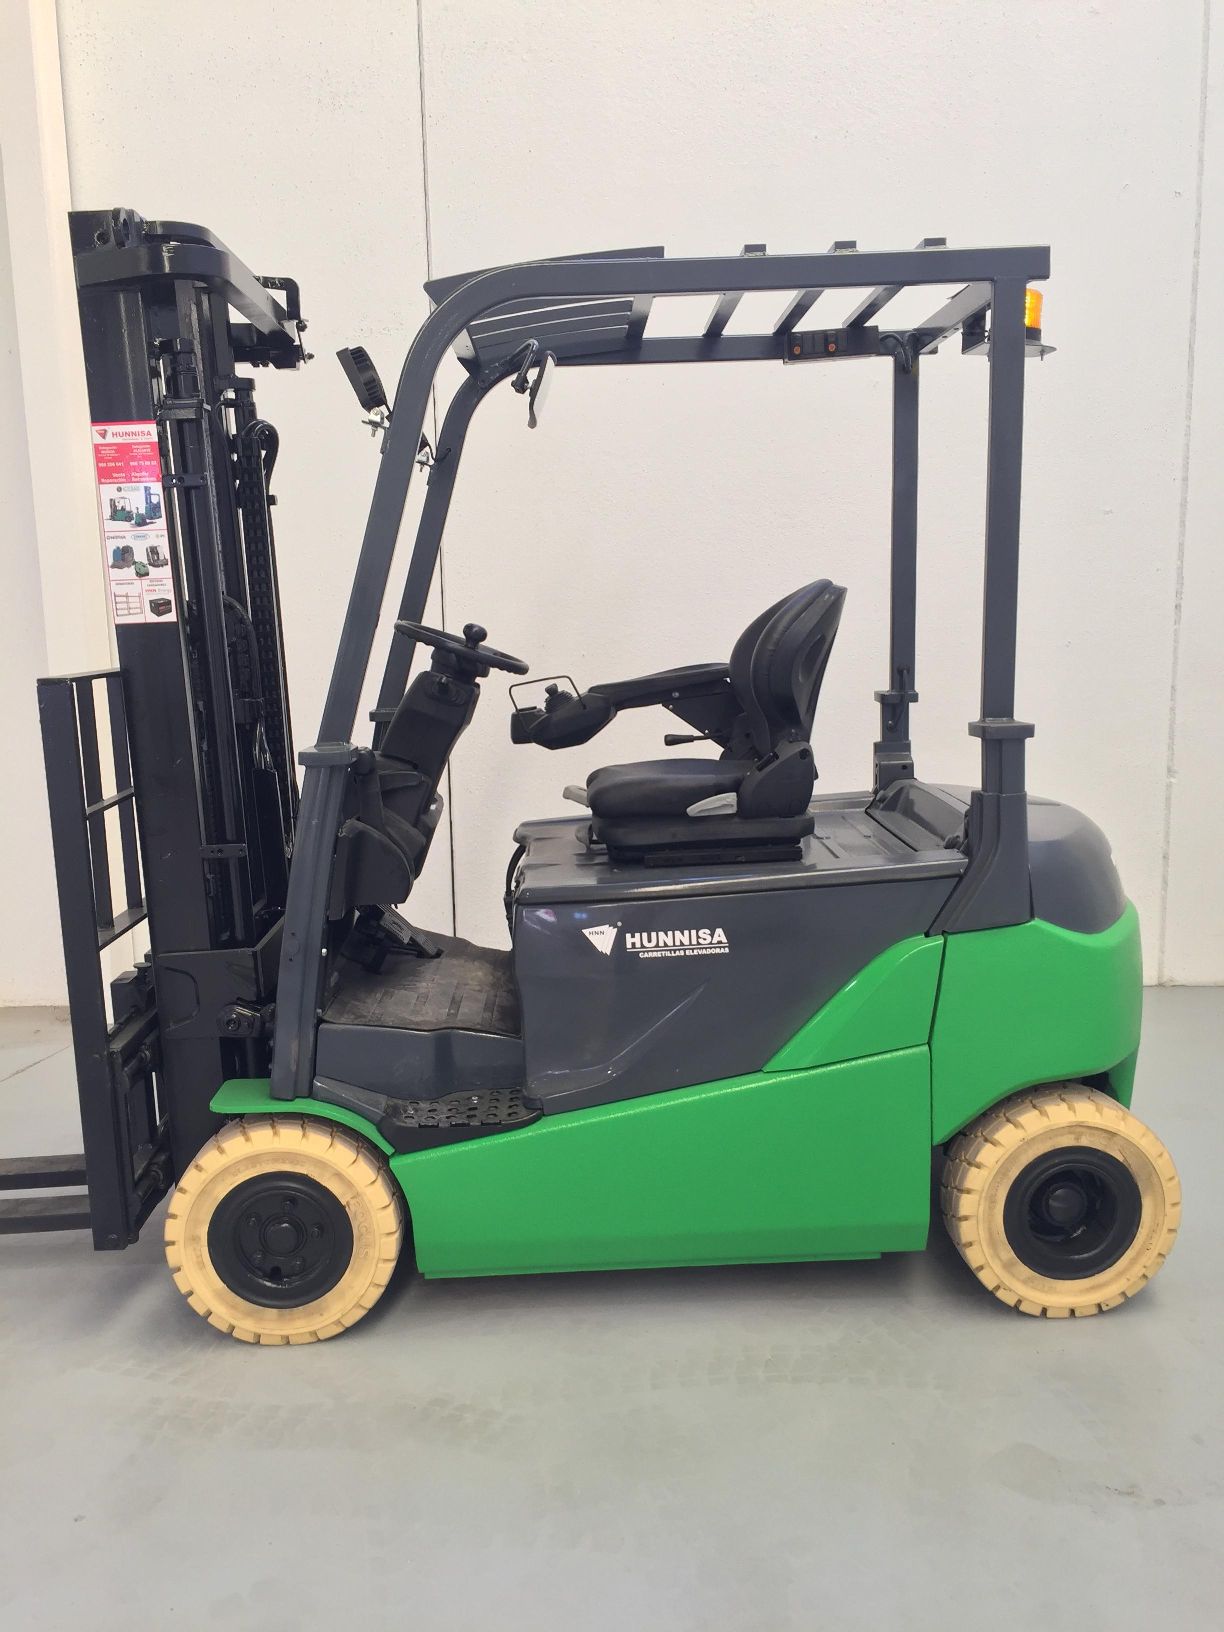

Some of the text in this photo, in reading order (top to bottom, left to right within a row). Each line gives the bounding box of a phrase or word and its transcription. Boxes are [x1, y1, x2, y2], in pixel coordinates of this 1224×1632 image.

[112, 430, 152, 438] HUNNISA
[625, 928, 728, 949] HUNNISA
[639, 947, 730, 958] CARRETILLAS ELEVADORAS
